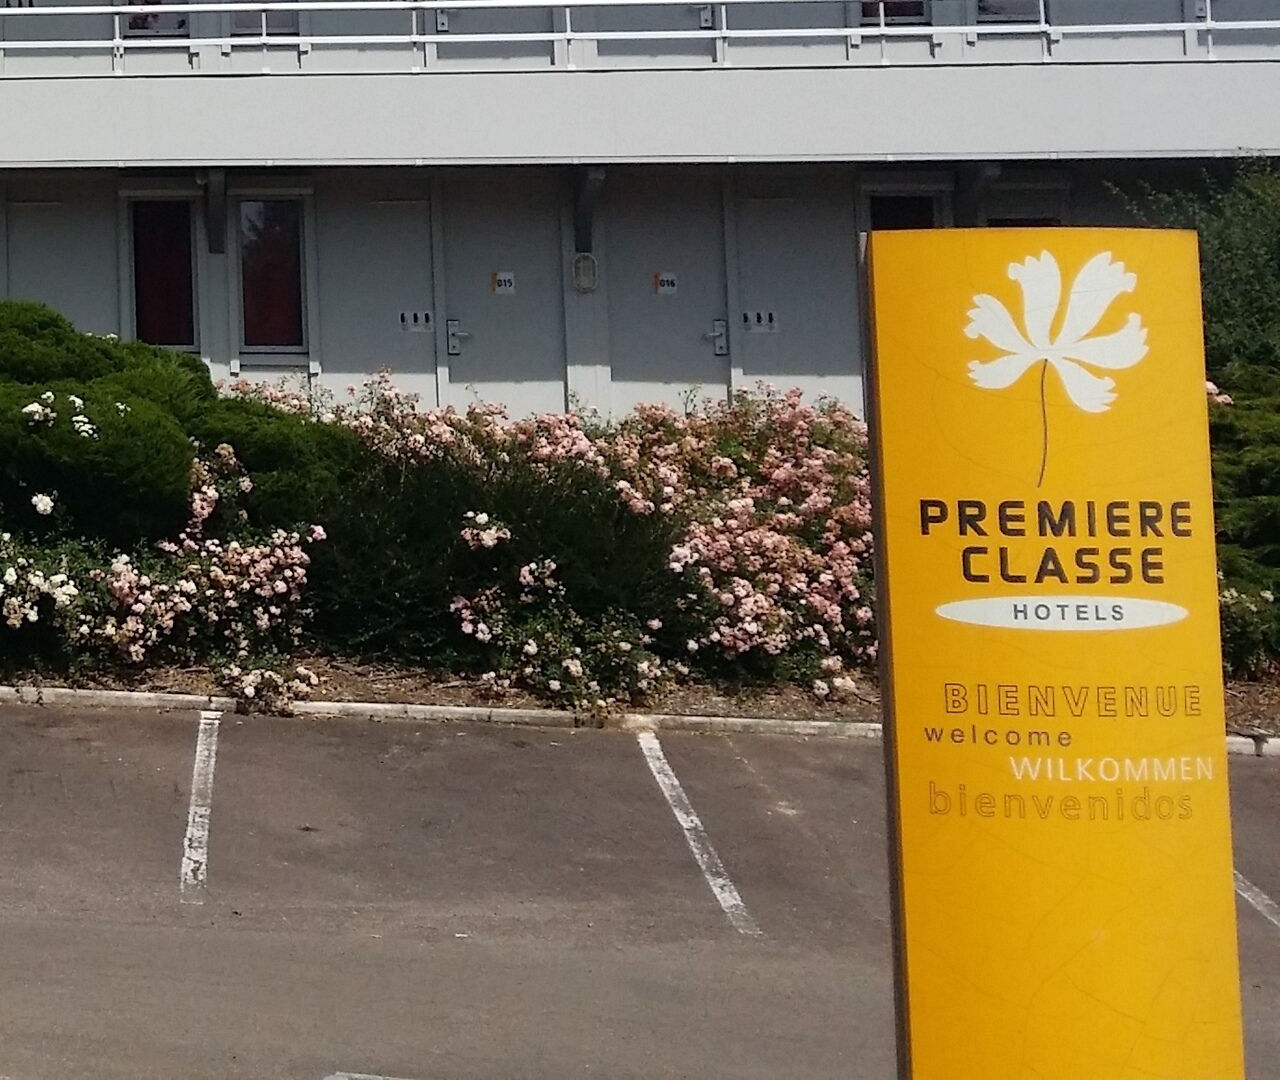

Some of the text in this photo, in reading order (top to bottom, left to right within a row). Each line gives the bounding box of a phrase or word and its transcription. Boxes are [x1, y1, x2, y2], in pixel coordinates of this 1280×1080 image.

[497, 279, 513, 288] 015
[659, 279, 676, 288] 016
[919, 497, 1192, 539] PREMIERE
[961, 546, 1166, 585] CLASSE
[1013, 603, 1125, 622] HOTELS
[944, 682, 1202, 718] BIENVENUE
[924, 724, 1073, 747] welcome
[1008, 756, 1215, 782] WILKOMMEN
[929, 781, 1194, 821] bienvenidos
